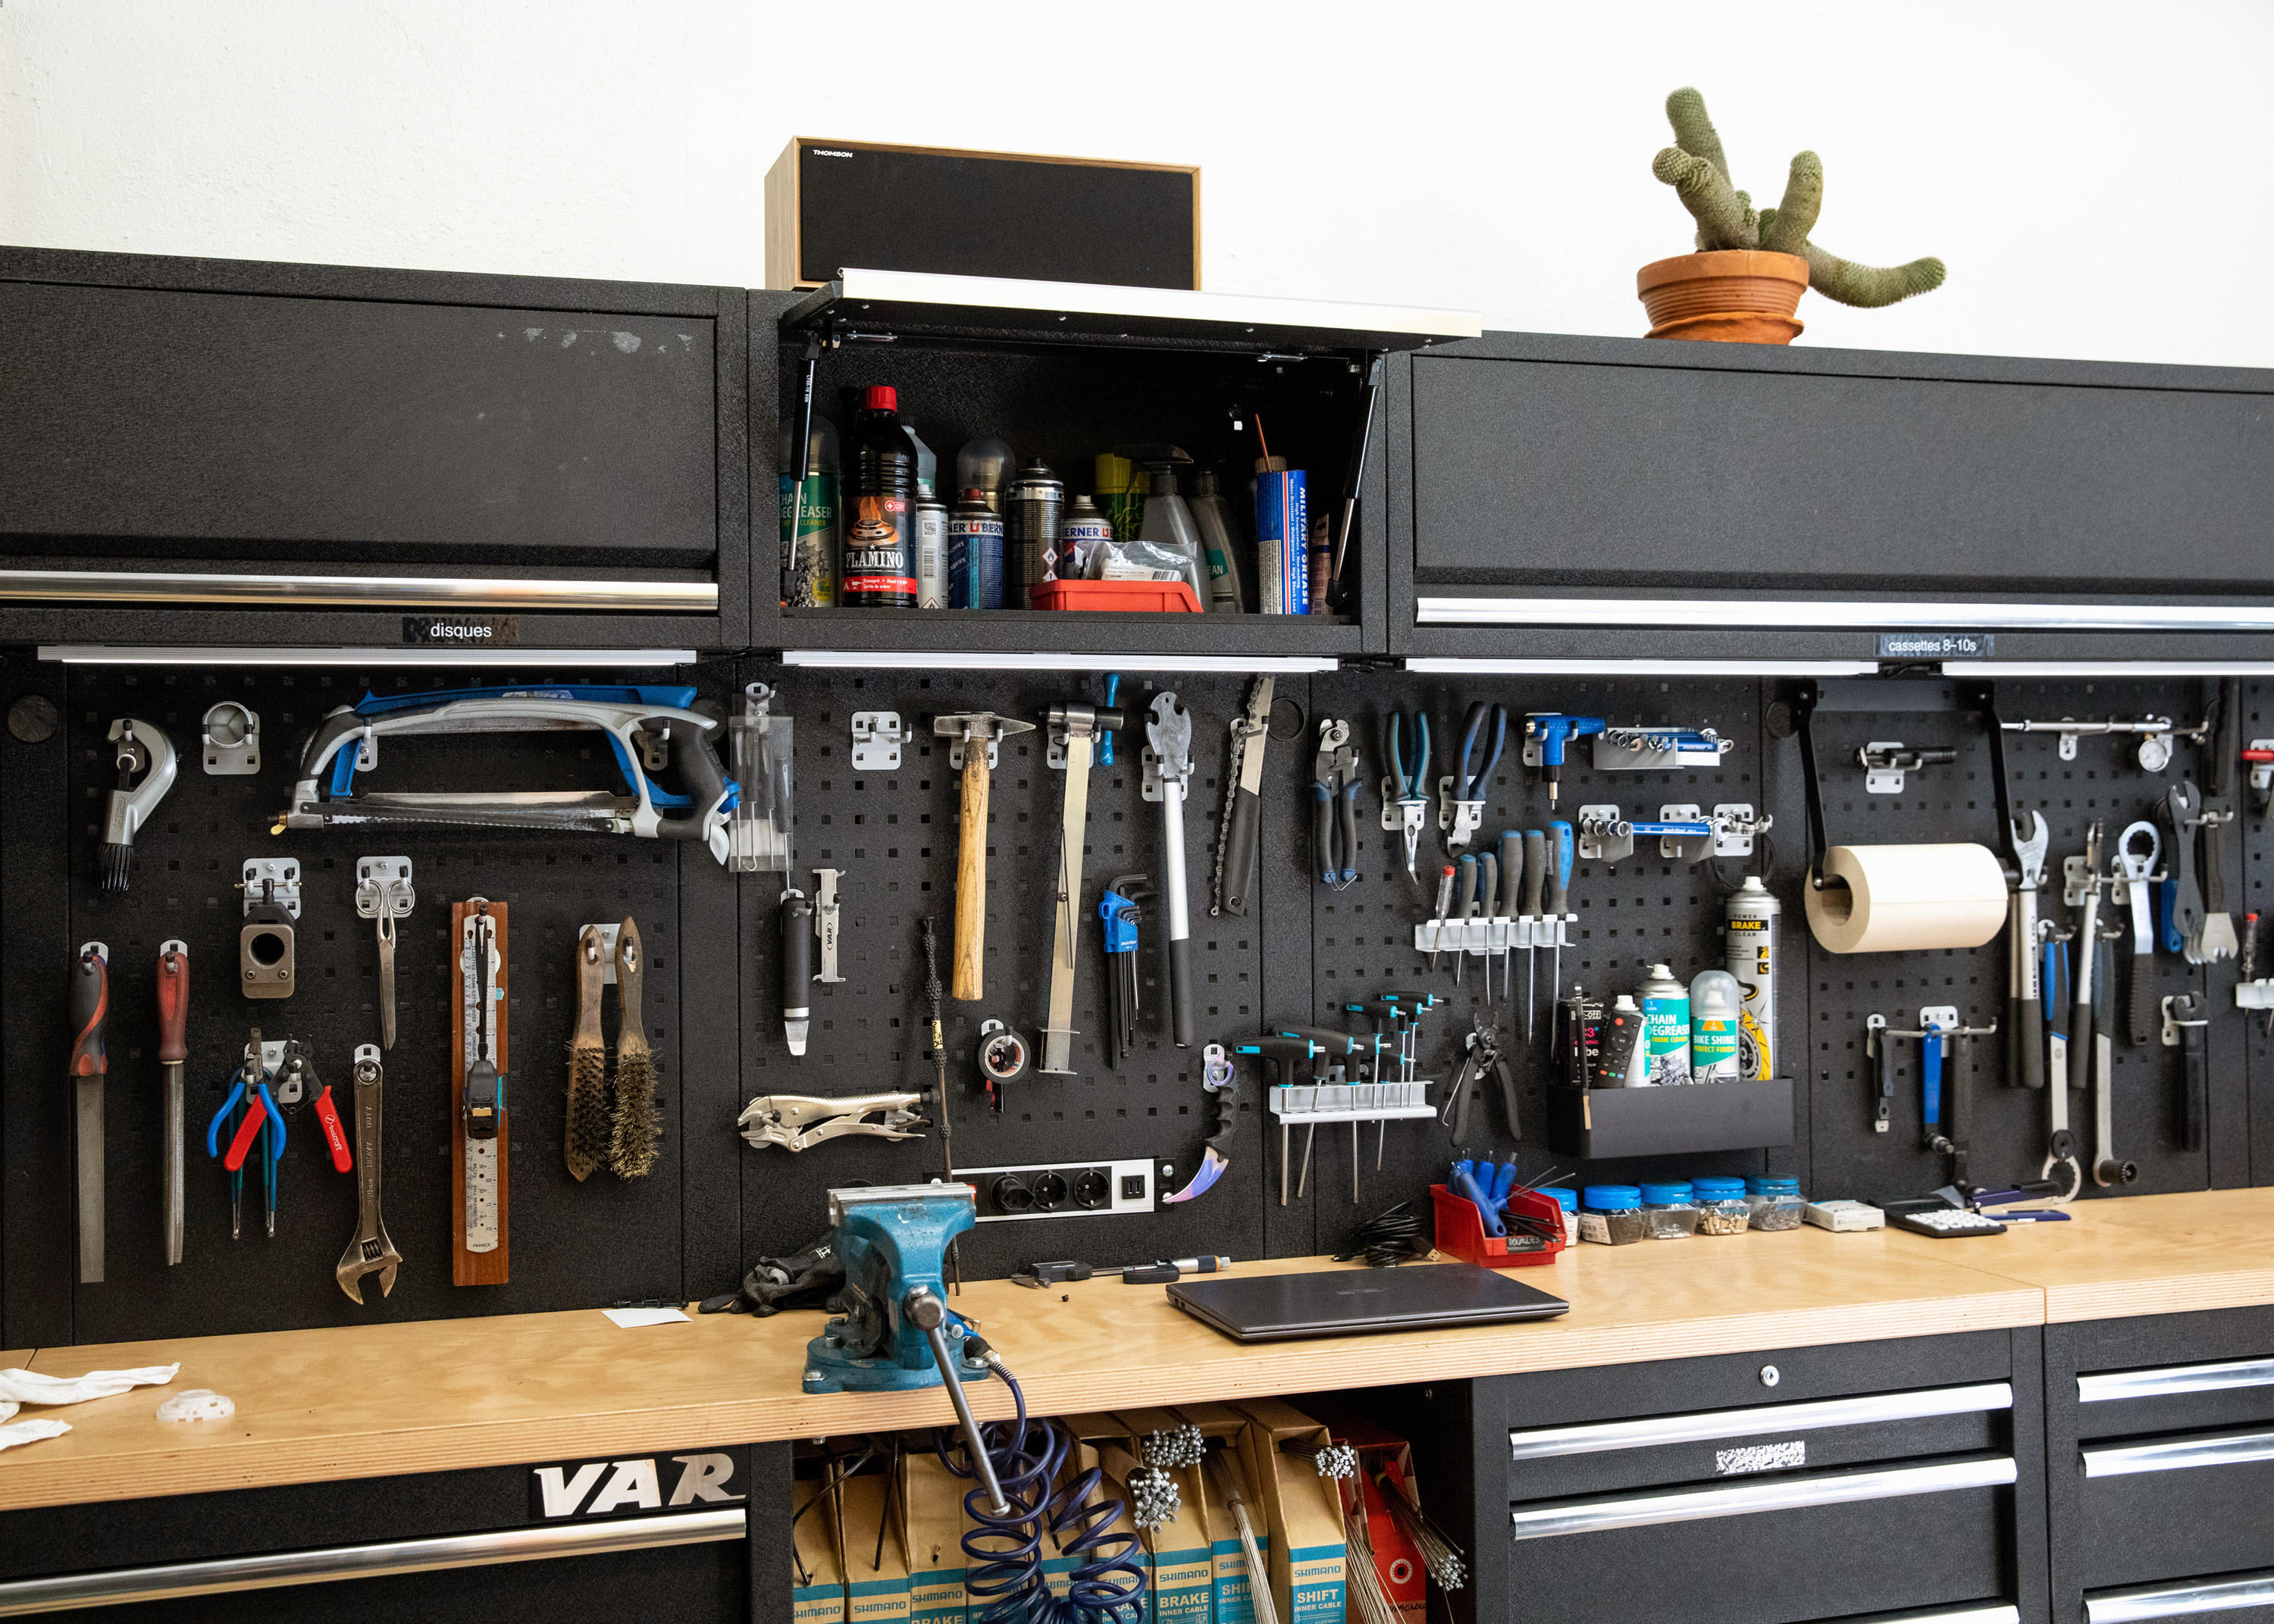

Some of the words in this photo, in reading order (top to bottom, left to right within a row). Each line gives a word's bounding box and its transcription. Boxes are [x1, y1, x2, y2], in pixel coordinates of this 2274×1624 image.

[813, 149, 853, 158] THOMSON
[1299, 487, 1308, 549] MILITARY
[948, 523, 966, 533] NER
[982, 523, 1004, 534] BERN
[1064, 527, 1099, 537] ERNER
[846, 552, 904, 569] FLAMINO
[1209, 565, 1223, 575] EAN
[431, 623, 492, 639] disques
[1888, 640, 1940, 652] cassettes
[1731, 922, 1762, 930] BRAKE
[1693, 1035, 1709, 1044] BIKE
[1711, 1035, 1736, 1045] SHINE
[1574, 1047, 1599, 1057] lbe
[533, 1453, 747, 1518] VAR
[1159, 1569, 1208, 1582] SHIMANO
[1294, 1565, 1341, 1578] SHIMANO
[912, 1591, 963, 1604] SHIMANO
[1160, 1592, 1209, 1608] BRAKE
[1297, 1588, 1339, 1604] SHIFT
[854, 1601, 907, 1613] SHIMANO
[1159, 1608, 1183, 1616] INNER
[1294, 1604, 1317, 1613] INNER
[1318, 1601, 1342, 1610] CABLE
